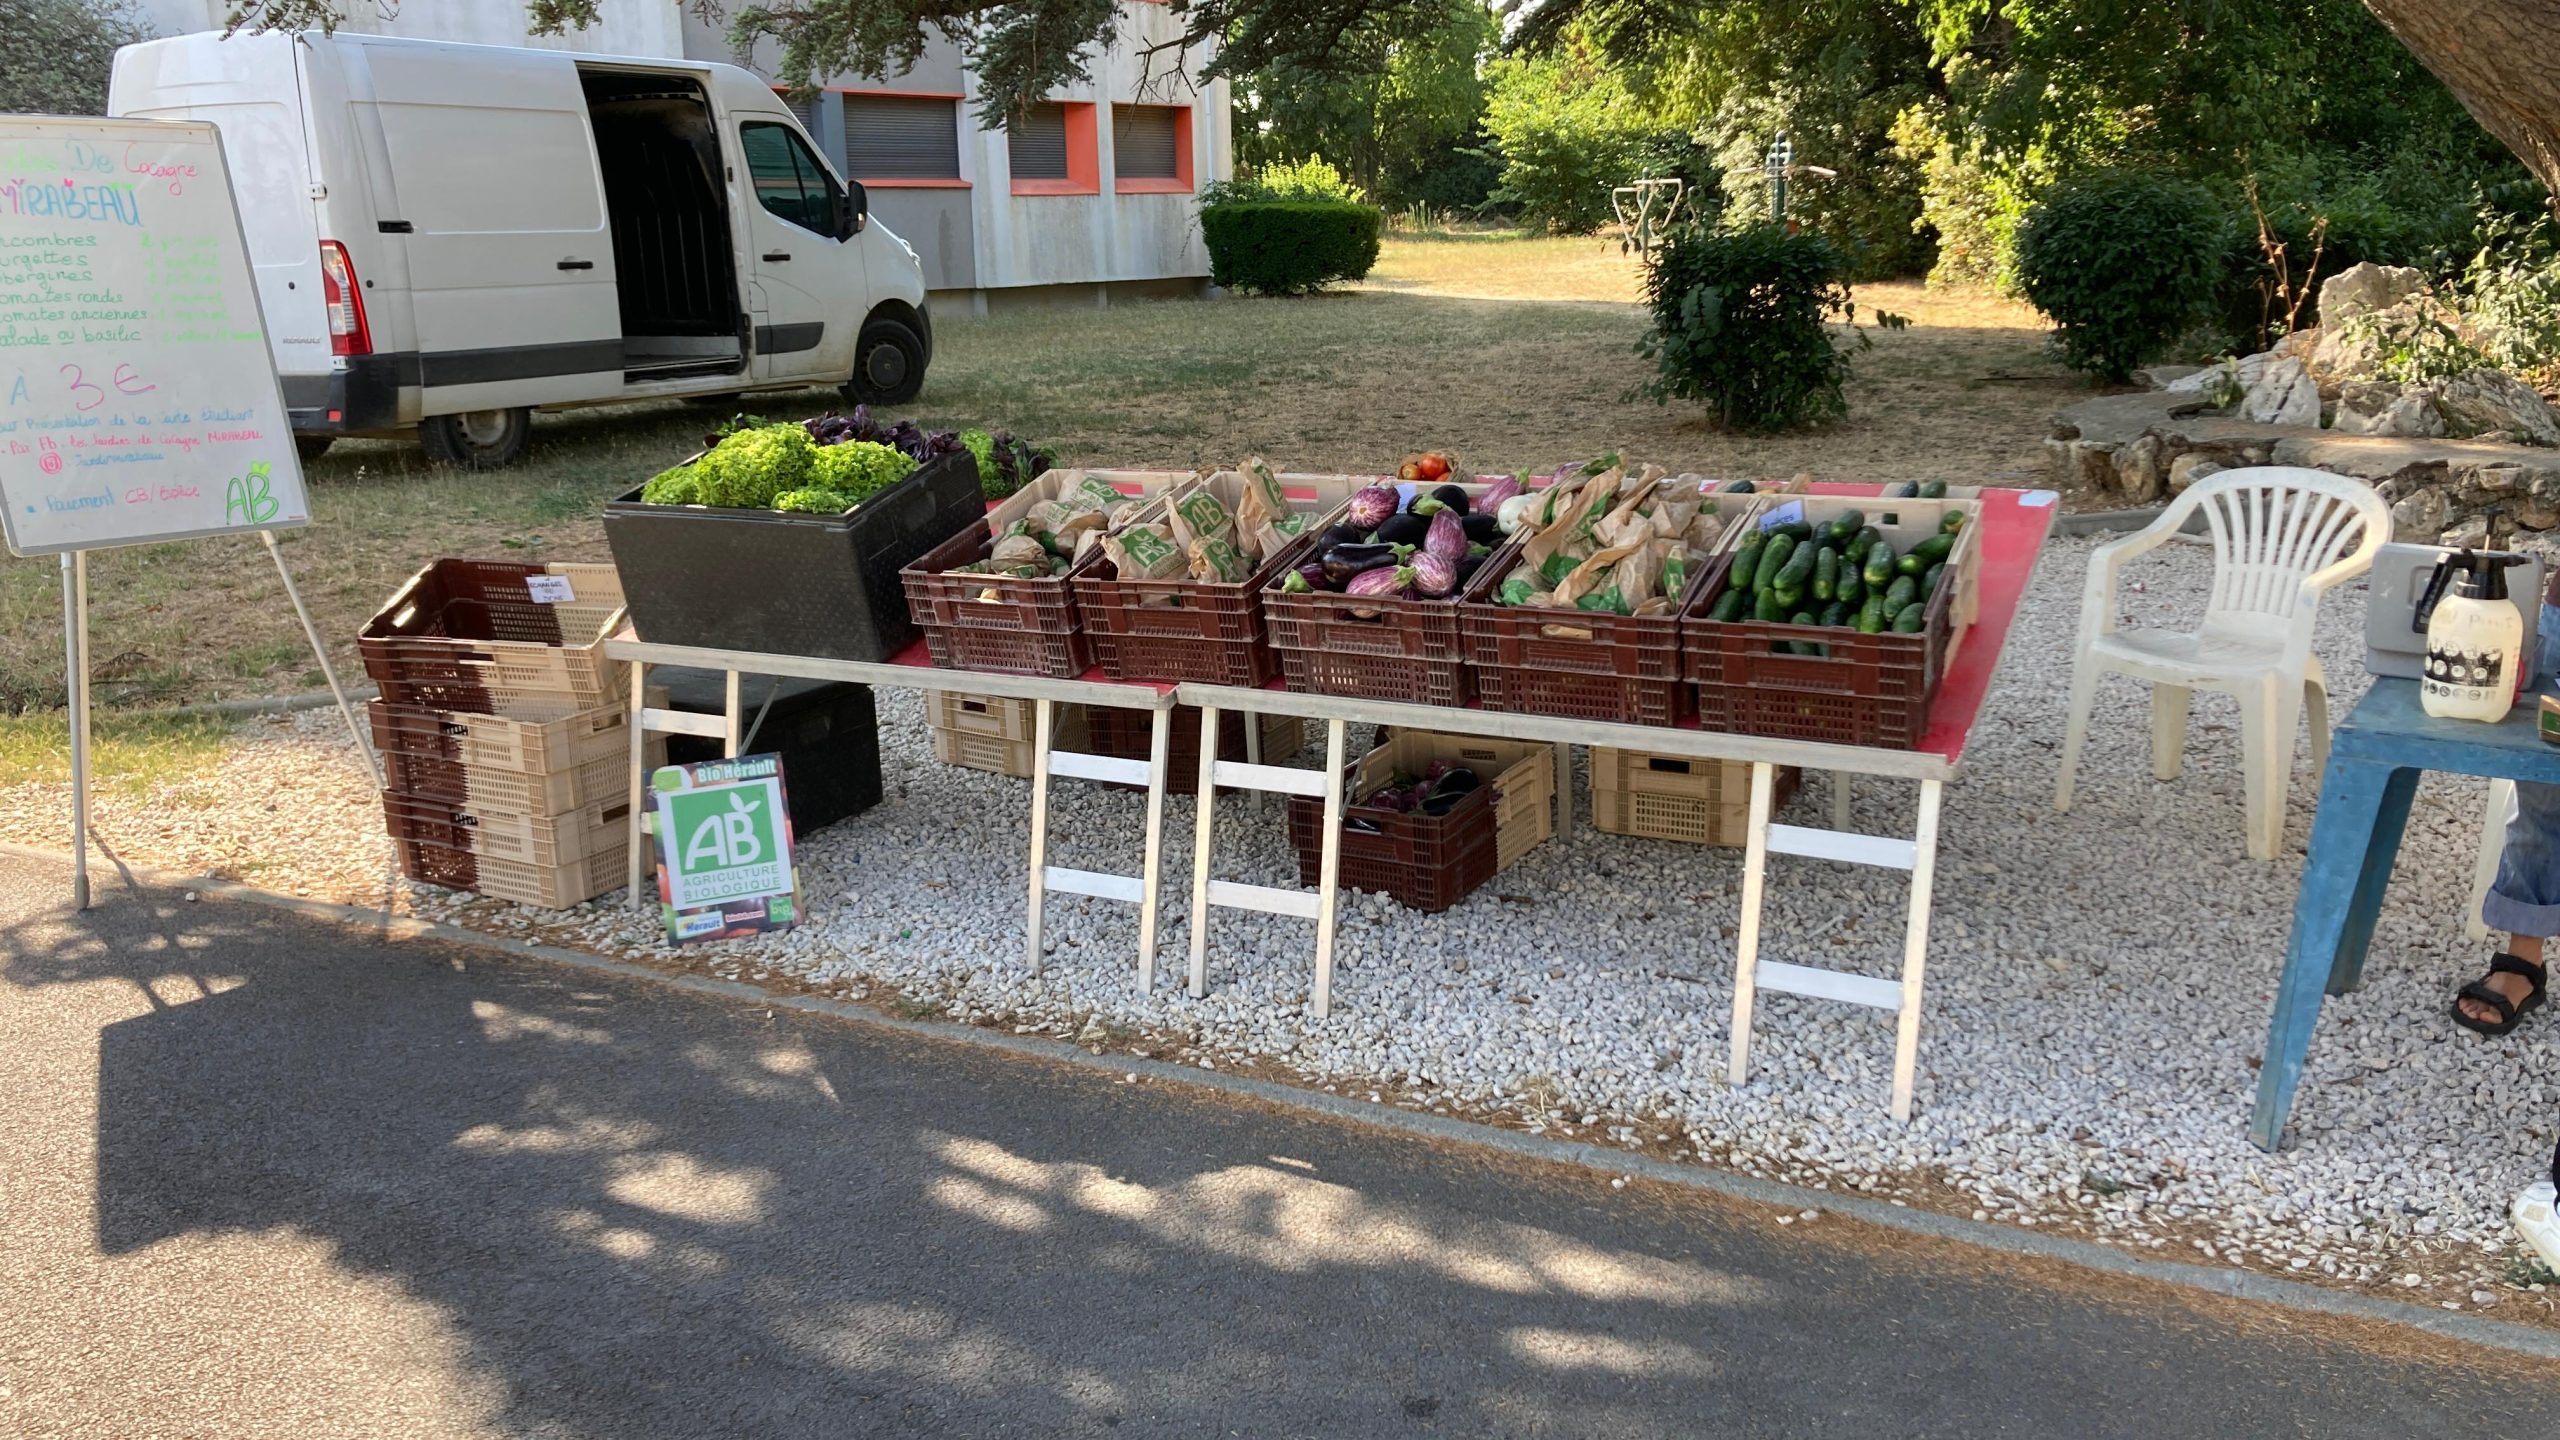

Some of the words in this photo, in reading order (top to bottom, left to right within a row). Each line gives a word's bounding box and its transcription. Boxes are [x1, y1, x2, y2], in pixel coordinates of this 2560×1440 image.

[65, 139, 114, 174] De
[125, 141, 198, 196] Cocagne
[71, 310, 148, 321] anciennes
[82, 324, 142, 341] basilic
[226, 472, 280, 526] AB
[1192, 498, 1222, 536] AB
[697, 764, 721, 783] Bio
[724, 758, 777, 779] Hérault
[684, 812, 761, 871] AB
[683, 864, 779, 888] AGRICULTURE
[684, 876, 781, 900] BIOLOGIQUE
